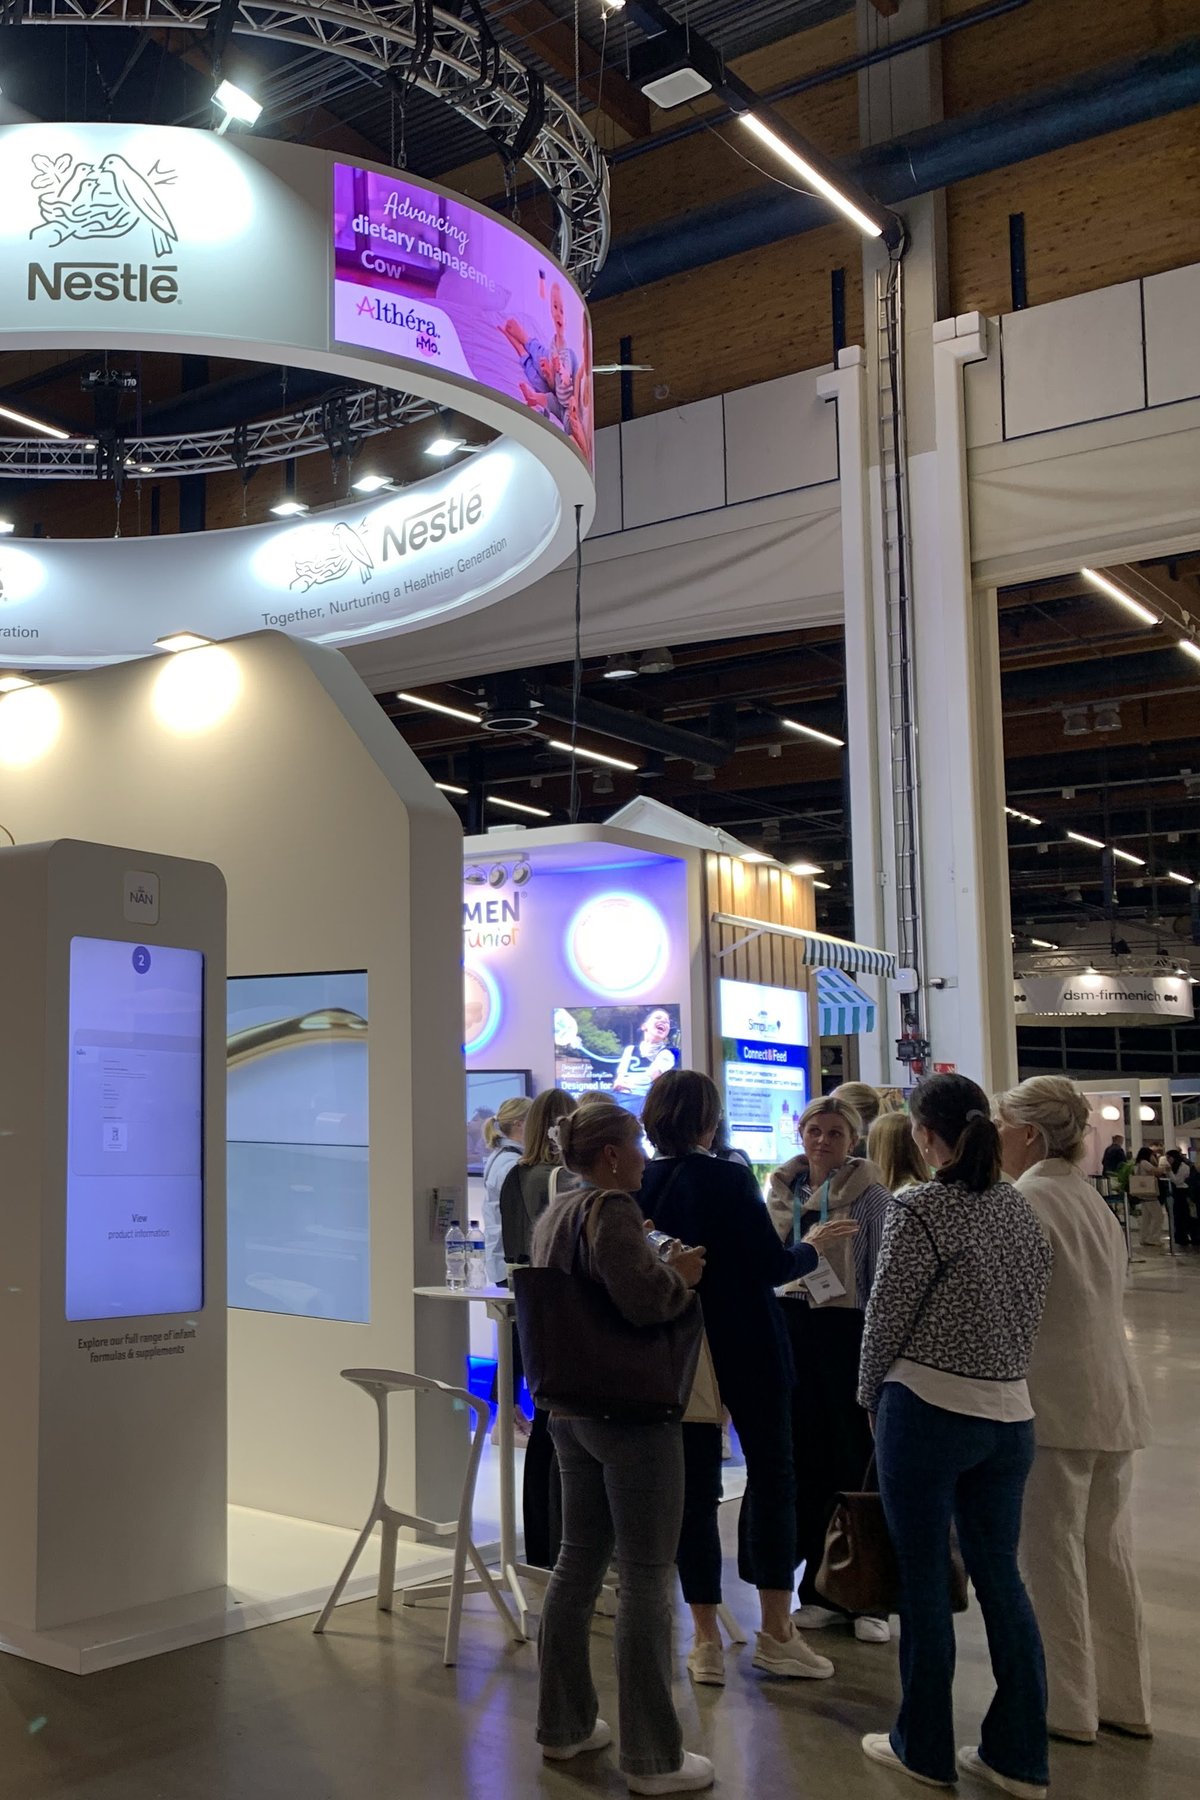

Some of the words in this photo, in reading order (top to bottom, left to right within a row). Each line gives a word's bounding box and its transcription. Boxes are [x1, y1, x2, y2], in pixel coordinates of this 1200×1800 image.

[383, 191, 470, 255] Advancing
[352, 213, 416, 252] dietary
[27, 261, 179, 304] Nestlé
[382, 482, 482, 562] Nestlé
[261, 606, 325, 627] Together,
[329, 590, 390, 615] Nurturing
[393, 586, 401, 598] a
[404, 566, 455, 595] Healthier
[457, 537, 508, 574] Generation
[129, 891, 154, 905] NAN
[138, 954, 146, 966] 2
[1063, 989, 1161, 1002] dsm-firmenich
[561, 1081, 599, 1092] Designed
[600, 1081, 613, 1090] for
[131, 1213, 148, 1223] View
[108, 1229, 133, 1240] product
[134, 1228, 170, 1239] information
[77, 1336, 108, 1351] Explore
[110, 1337, 123, 1346] our
[125, 1333, 138, 1345] full
[140, 1332, 162, 1345] range
[163, 1330, 173, 1341] of
[173, 1328, 196, 1340] infant
[90, 1350, 126, 1363] formulas
[127, 1349, 134, 1359] &
[135, 1345, 185, 1361] supplements
